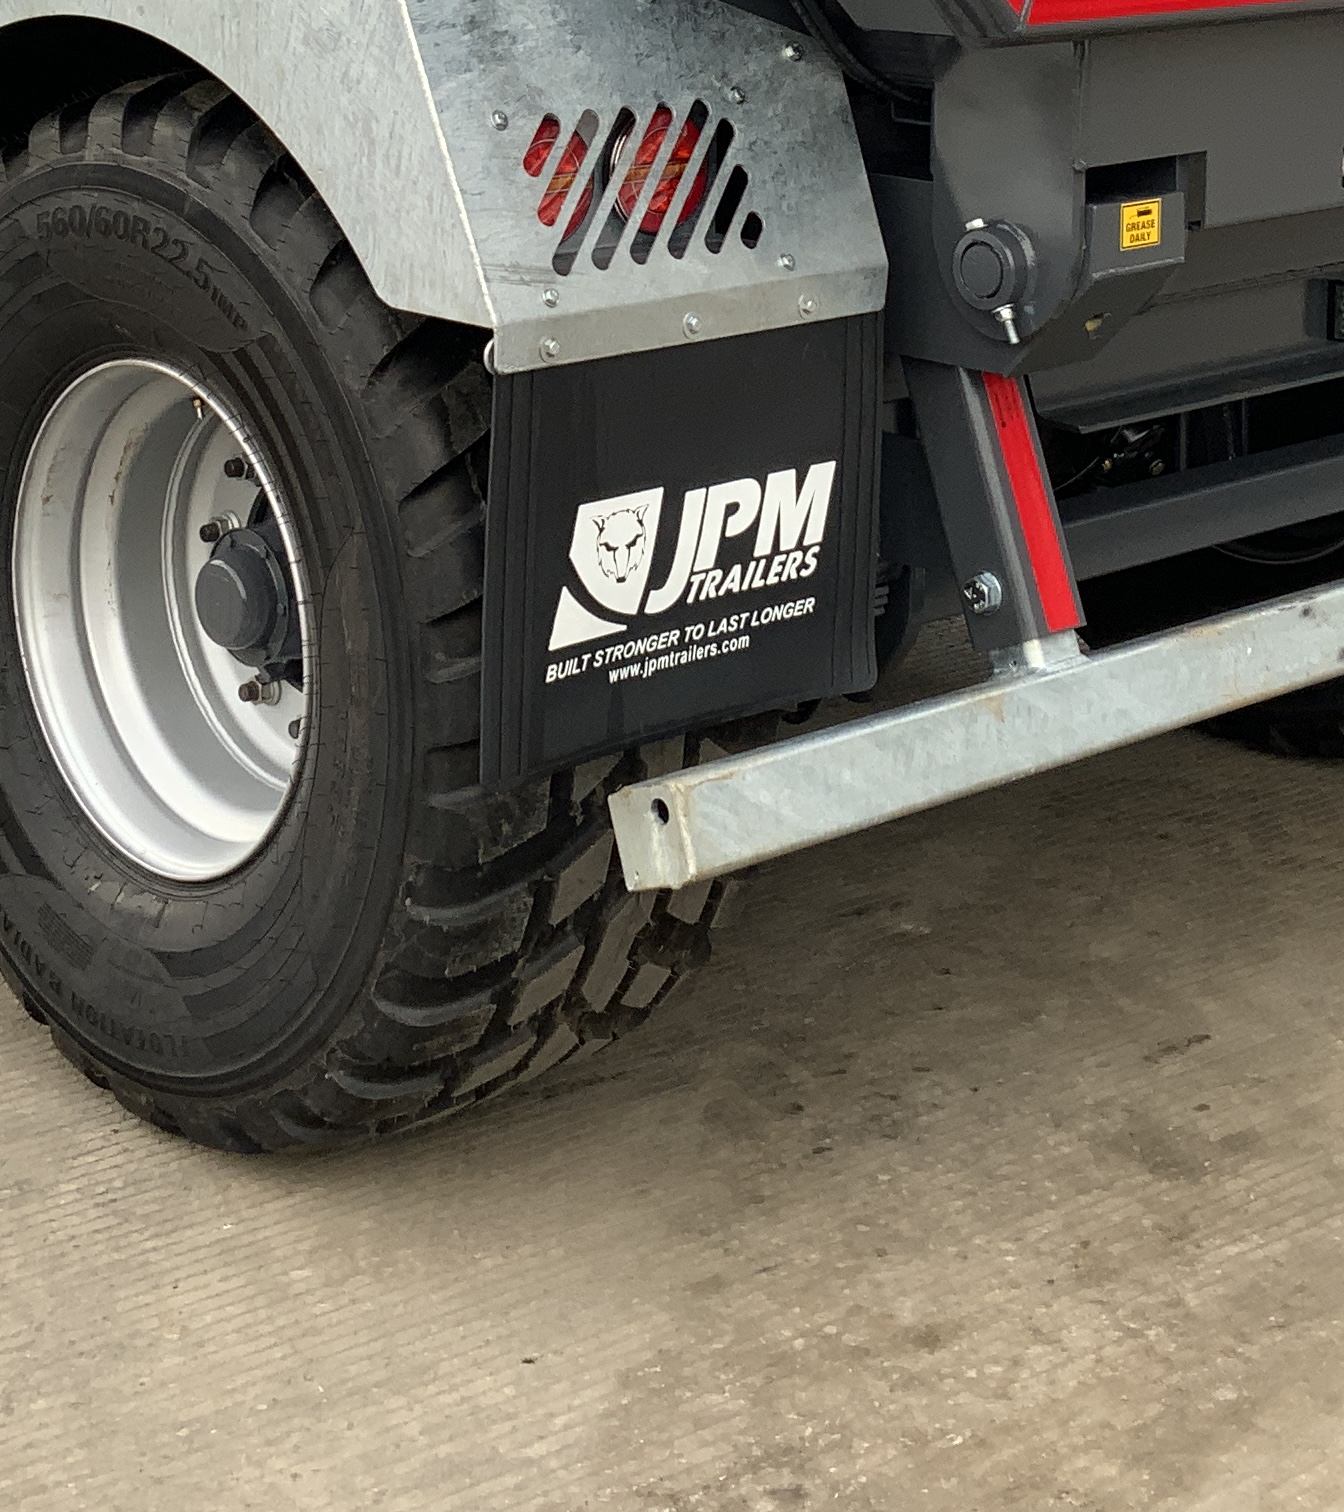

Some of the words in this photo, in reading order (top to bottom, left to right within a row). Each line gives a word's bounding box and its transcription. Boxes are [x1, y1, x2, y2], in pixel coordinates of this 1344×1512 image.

[36, 202, 214, 293] 560/60R22.5
[1125, 218, 1156, 233] GREASE
[1129, 231, 1152, 244] DAILY
[643, 460, 837, 616] JPM
[686, 544, 820, 604] TRAILERS
[545, 653, 592, 684] BUILT
[592, 629, 680, 668] STRONGER
[684, 623, 705, 644] TO
[706, 612, 751, 639] LAST
[750, 596, 816, 627] LONGER
[608, 634, 751, 685] www.jpmtrailers.com
